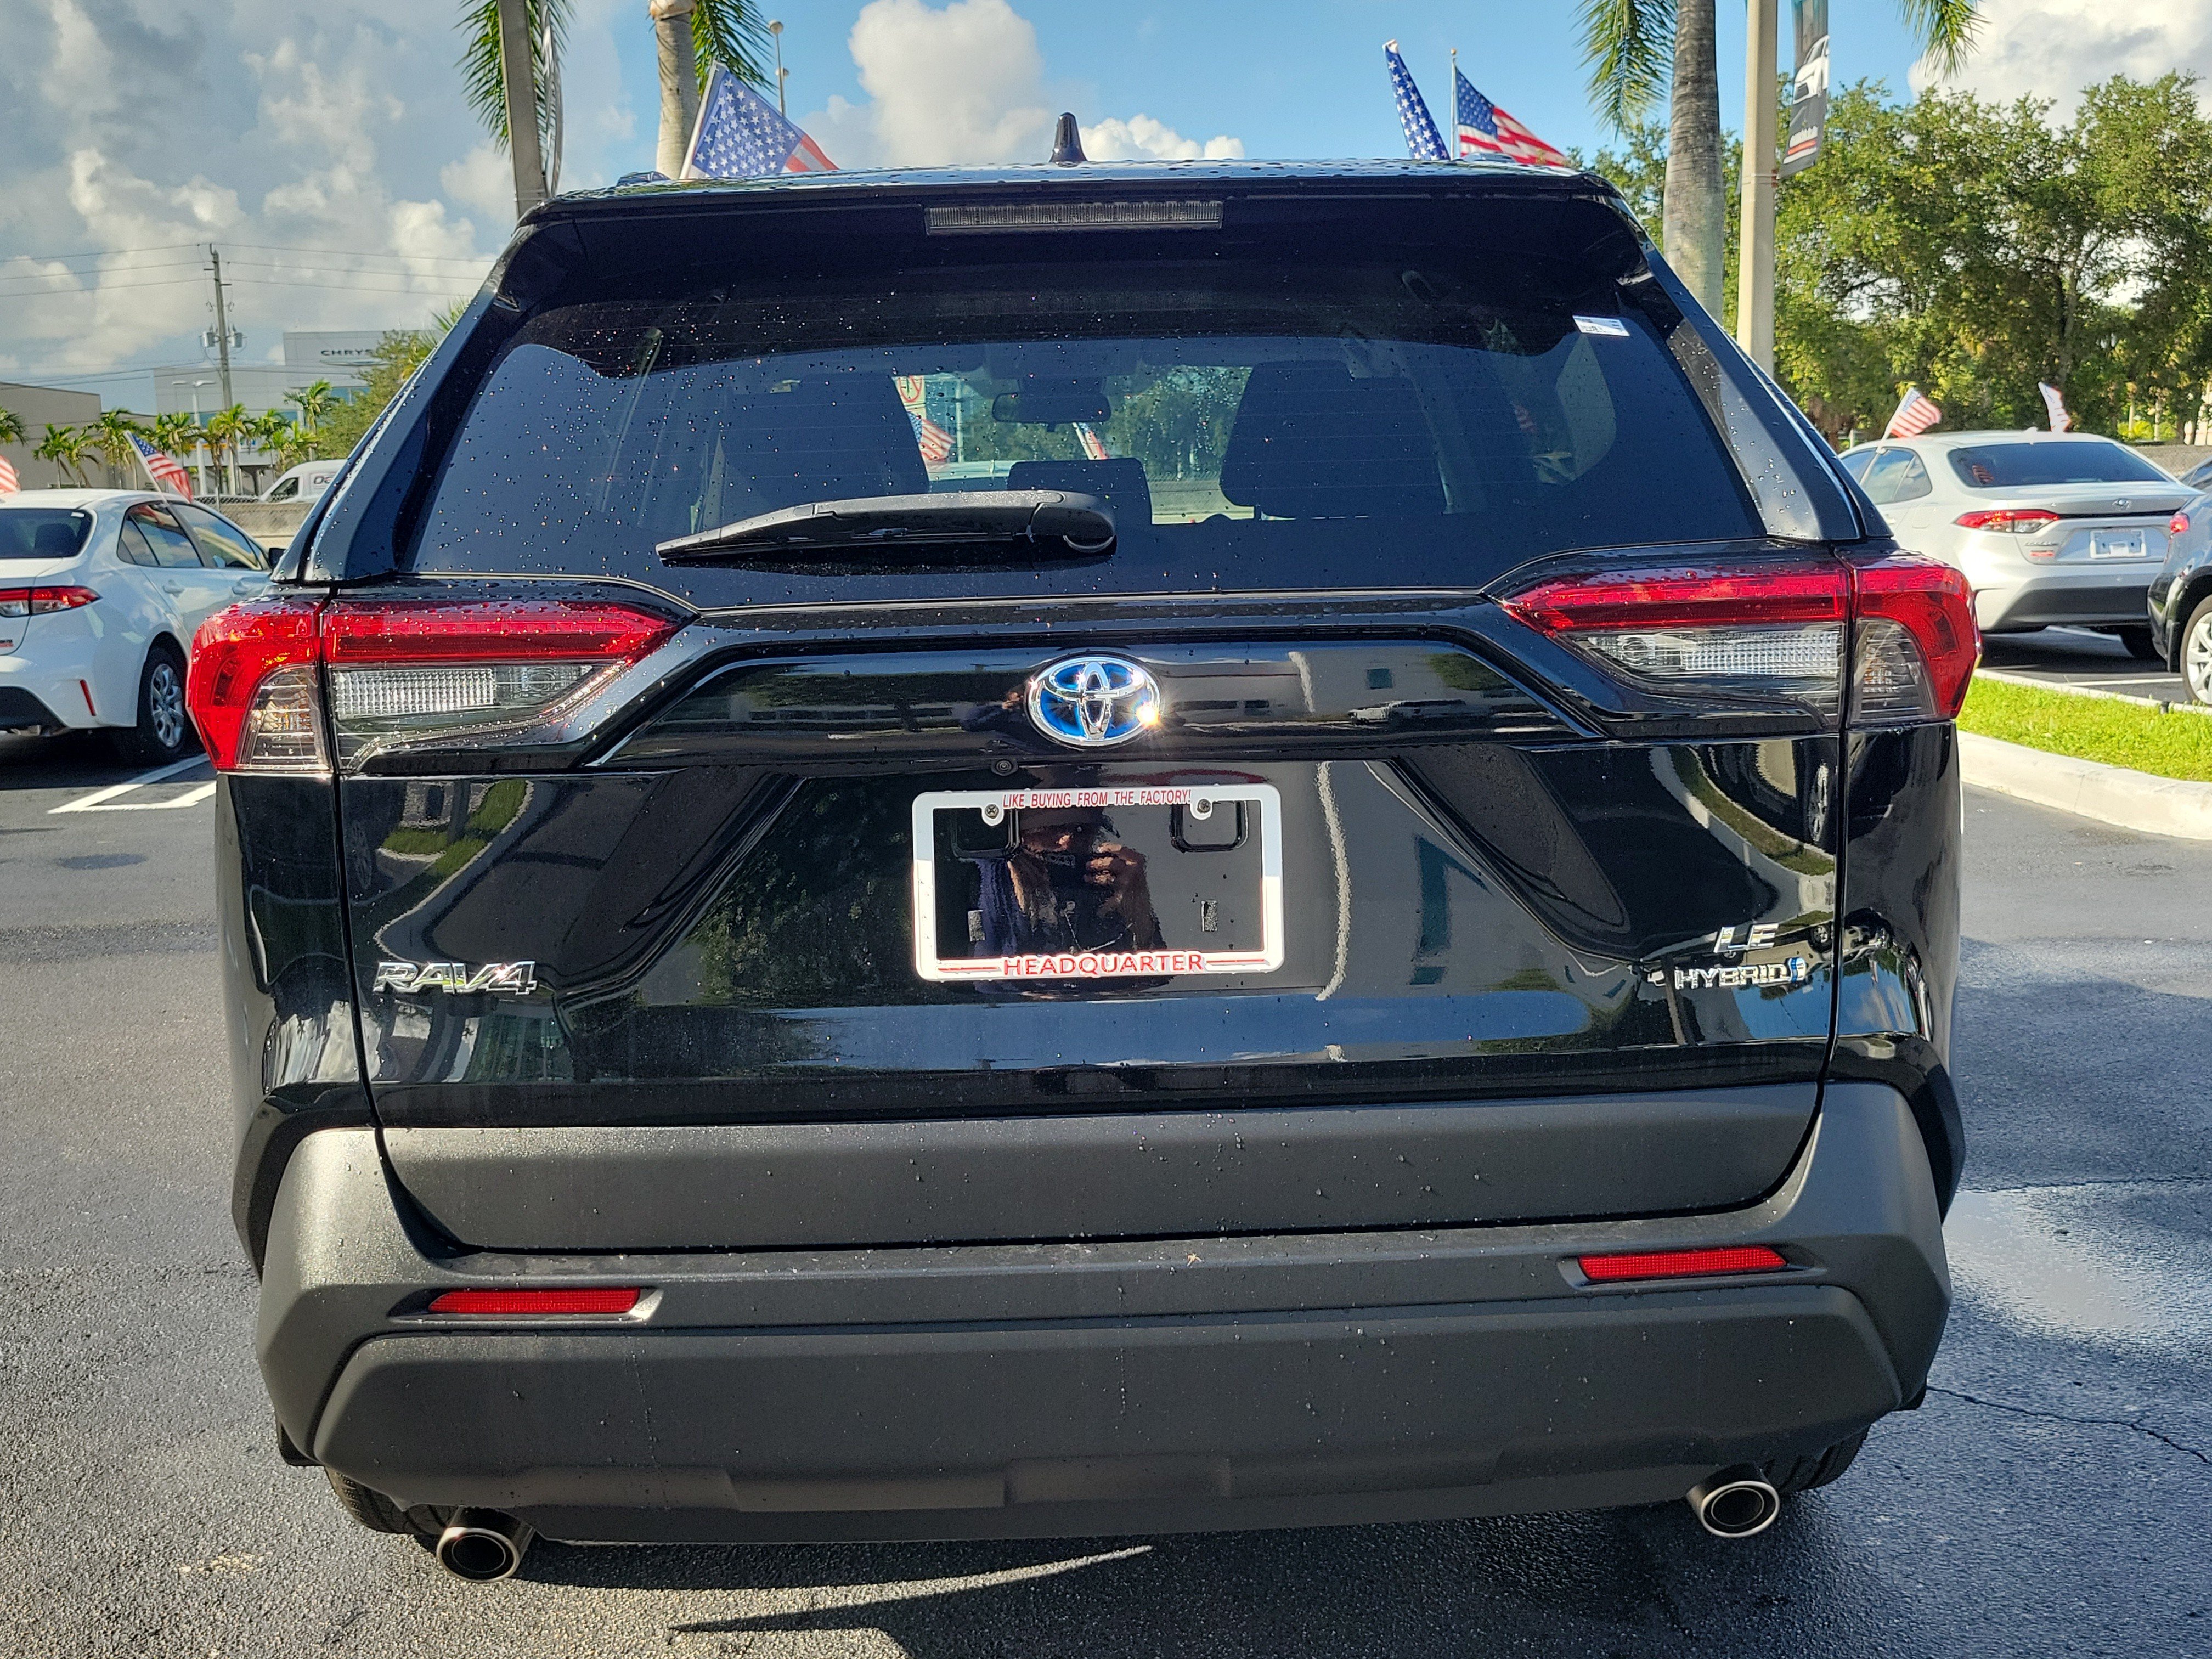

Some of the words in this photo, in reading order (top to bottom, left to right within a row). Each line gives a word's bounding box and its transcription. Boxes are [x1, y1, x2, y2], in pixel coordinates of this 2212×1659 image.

[1003, 794, 1025, 808] LIKE
[1031, 793, 1071, 808] BUYING
[1077, 792, 1108, 806] FROM
[1114, 791, 1134, 805] THE
[1141, 789, 1191, 805] FACTORY!
[1713, 923, 1779, 953] LE
[373, 961, 537, 995] RAV4
[1003, 953, 1203, 977] HEADQUARTER
[1674, 963, 1791, 990] HYBRID
